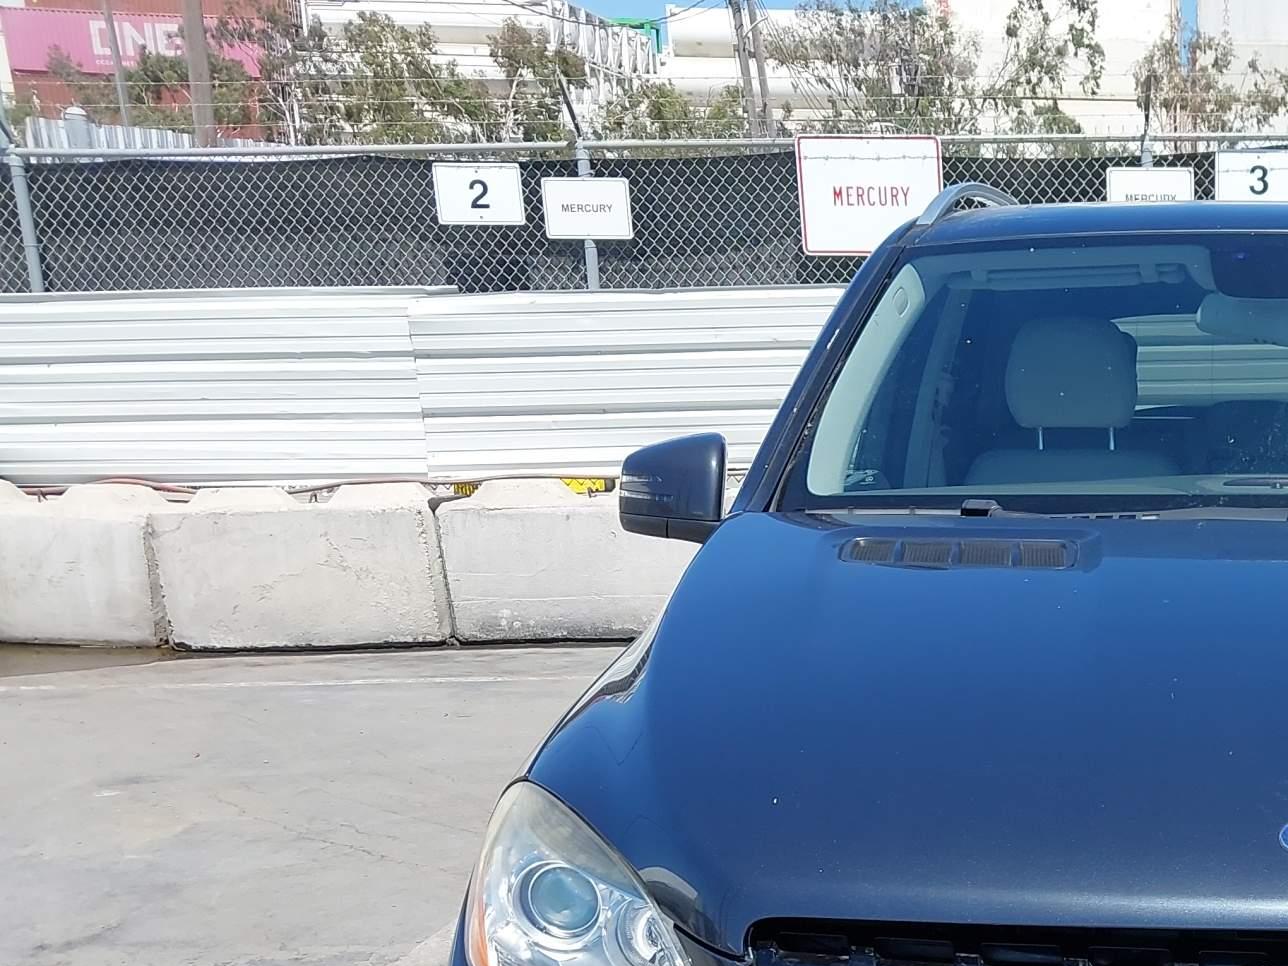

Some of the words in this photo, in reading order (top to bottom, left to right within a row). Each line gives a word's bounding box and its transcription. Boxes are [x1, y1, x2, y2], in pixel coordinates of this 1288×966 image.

[1249, 164, 1269, 196] 3
[468, 178, 491, 209] 2
[832, 185, 911, 207] MERCURY
[560, 203, 613, 213] MERCURY
